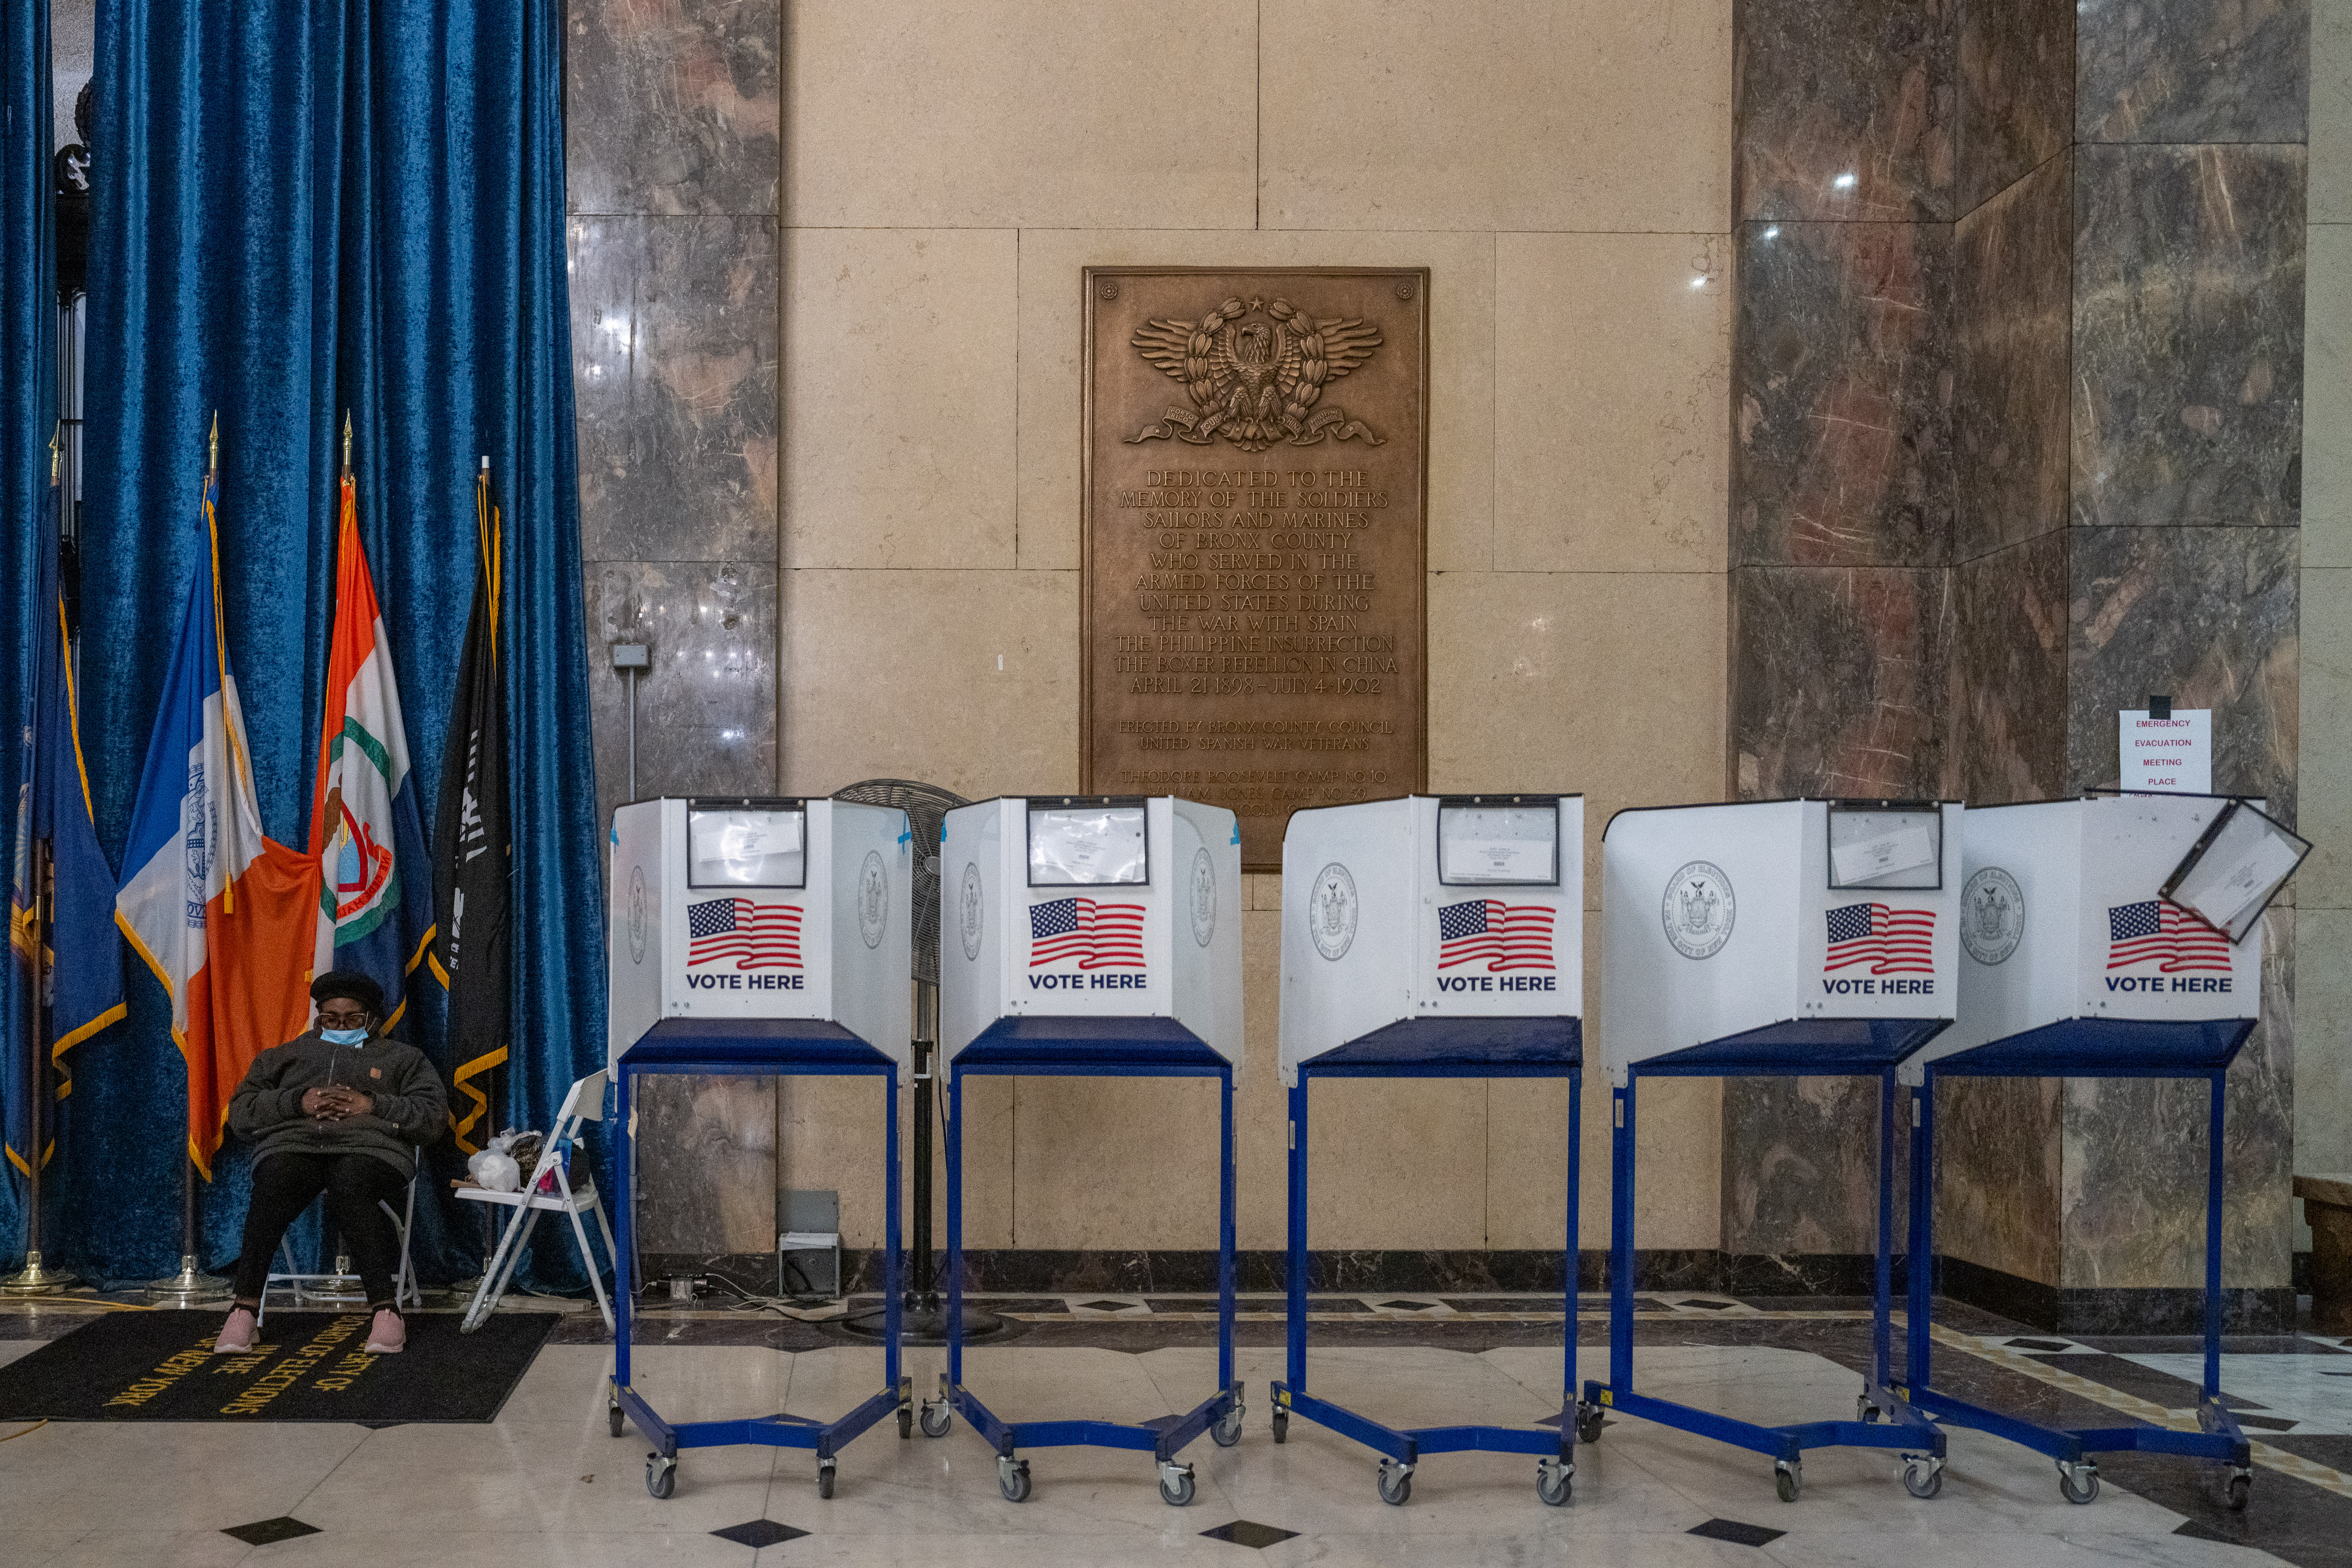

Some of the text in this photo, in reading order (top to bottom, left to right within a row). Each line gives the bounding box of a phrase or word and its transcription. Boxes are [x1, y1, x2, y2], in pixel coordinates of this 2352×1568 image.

[1171, 408, 1194, 419] PORTO
[1171, 413, 1188, 422] RICO
[1146, 470, 1369, 487] DEDICATED TO THE
[1120, 491, 1388, 508] MEMORY OF THE SOLDIERS
[1144, 512, 1368, 528] SAILORS AND MARINES
[1160, 533, 1351, 549] OF BRONX COUNTY
[1150, 554, 1359, 570] WHO SERVED IN THE
[1135, 574, 1375, 590] ARMED FORCES OF THE
[1139, 594, 1369, 612] UNITED STATES DURING
[1149, 616, 1358, 632] THE WAR WITH SPAIN
[1115, 636, 1394, 653] THE PHILIPPINE INSURRECTION
[1114, 657, 1398, 673] THE BOXER REBELLION IN CHINA
[1130, 677, 1182, 693] APRIL
[1271, 678, 1310, 694] JULY
[1119, 720, 1392, 734] ERECTED BY BRONX COUNTY COUNCIL
[1141, 737, 1369, 750] UNITED SPANISH WAR VETERANS
[1122, 771, 1199, 784] THEODORE
[1208, 771, 1288, 784] ROOSEVELT
[1296, 771, 1339, 784] CAMP
[1344, 771, 1366, 784] NO
[1220, 787, 1263, 801] JONES
[1271, 787, 1315, 801] CAMP
[1323, 787, 1343, 801] NO
[1351, 788, 1367, 801] 59
[1231, 804, 1279, 816] NCOLN
[686, 974, 804, 989] VOTE HERE
[1029, 974, 1147, 989] VOTE HERE
[1438, 977, 1556, 991] VOTE HERE
[1822, 979, 1935, 994] VOTE HERE
[2106, 977, 2233, 993] VOTE HERE
[154, 1350, 215, 1375] NEW
[213, 1356, 267, 1374] THE
[220, 1315, 371, 1414] BOARD OF ELECTIONS
[102, 1377, 180, 1407] YORK
[312, 1377, 353, 1392] OF
